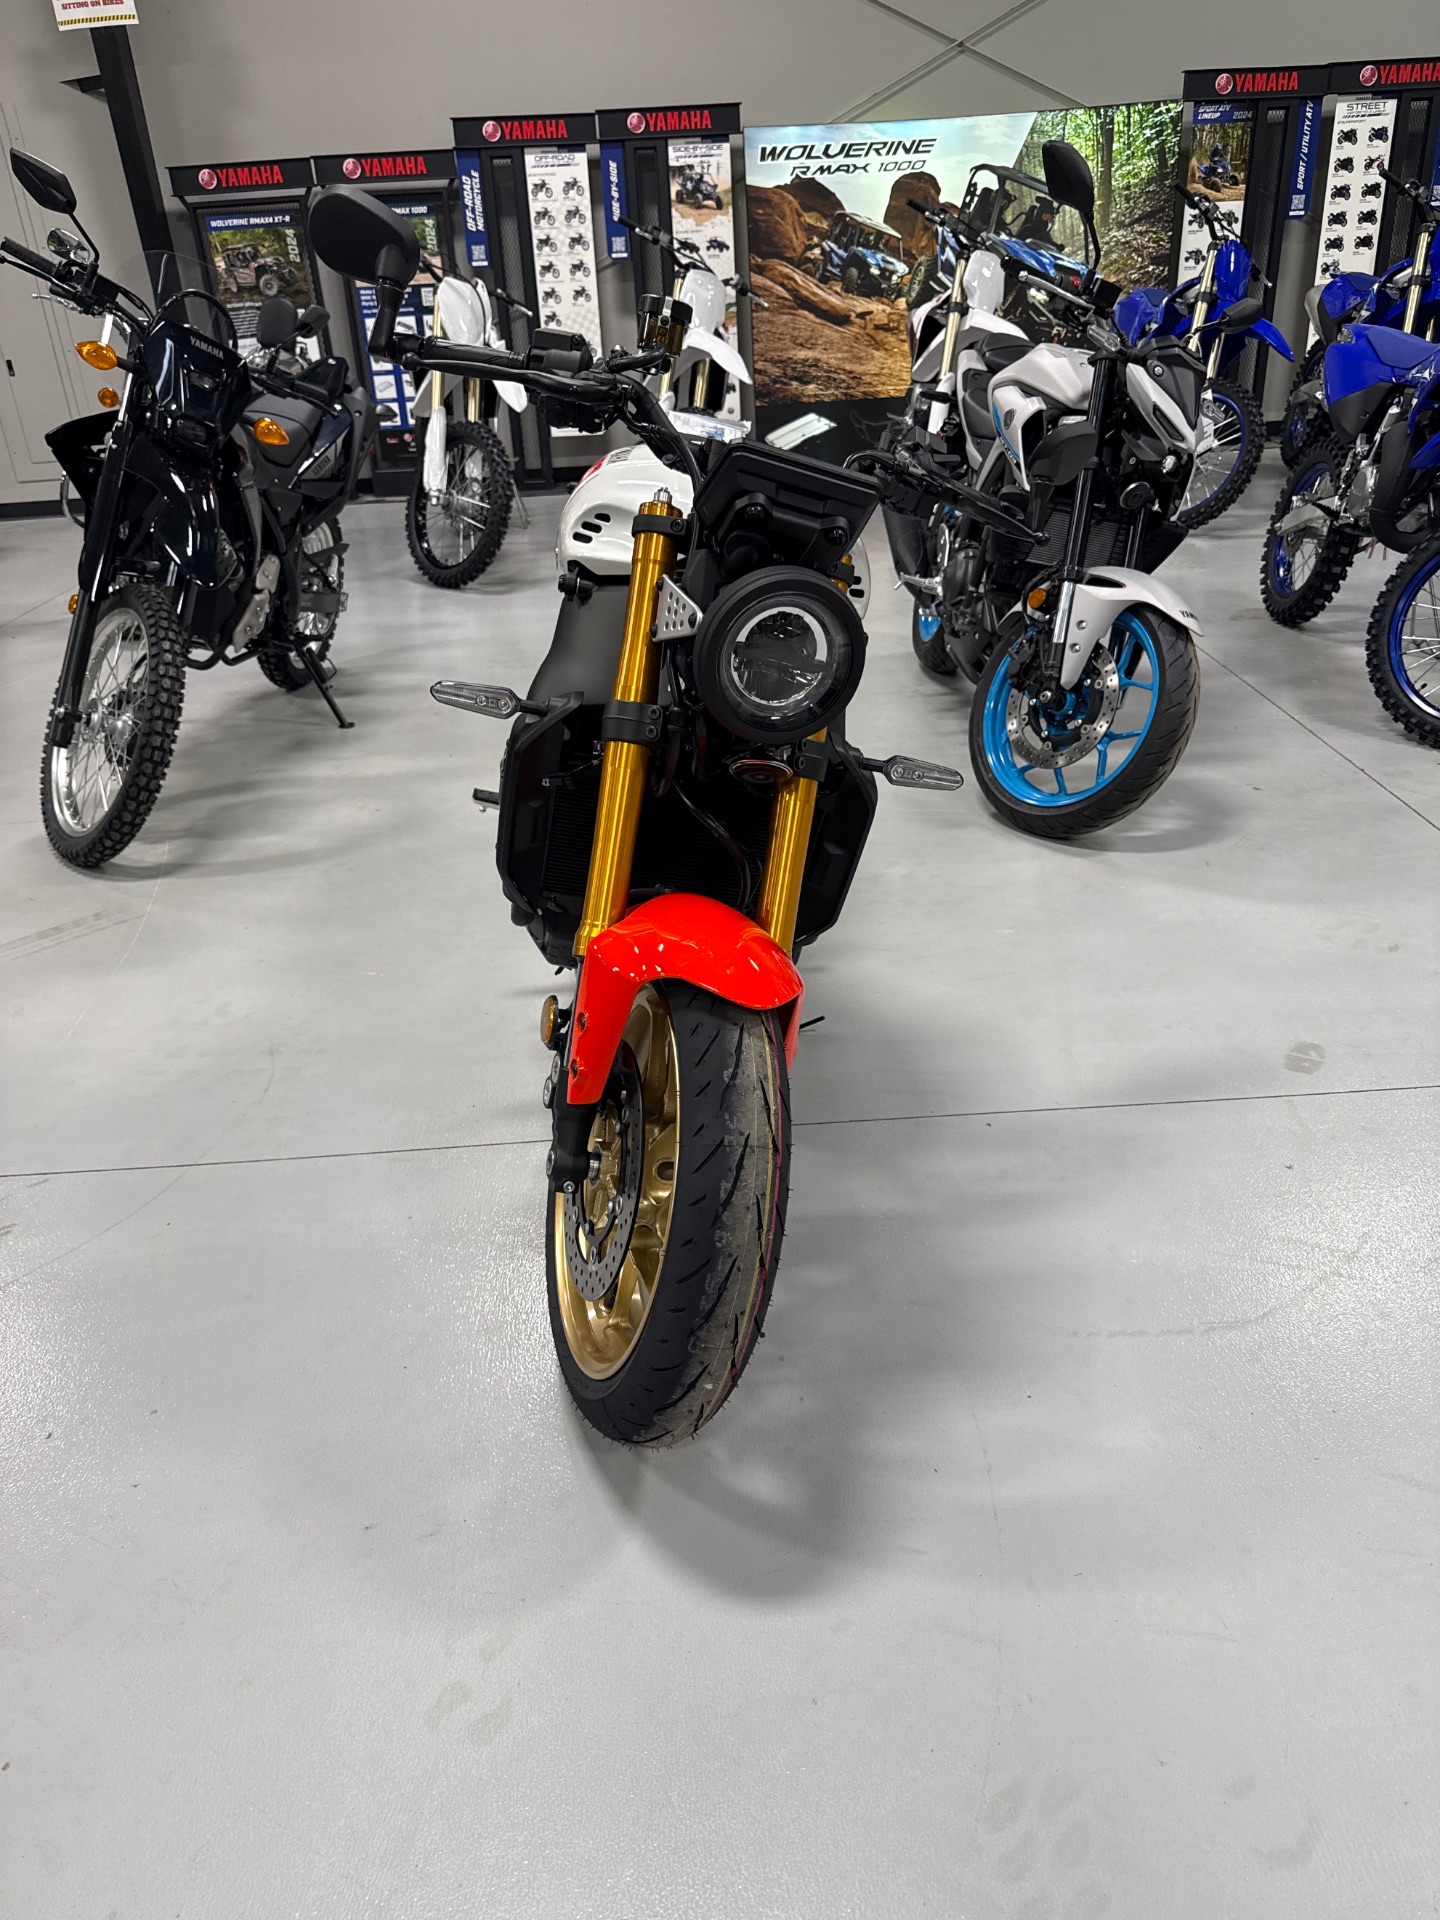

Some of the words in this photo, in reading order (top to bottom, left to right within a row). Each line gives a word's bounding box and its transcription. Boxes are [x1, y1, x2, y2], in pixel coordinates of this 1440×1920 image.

[61, 1, 89, 10] SITTING
[1235, 71, 1299, 93] YAMAHA
[1380, 63, 1440, 84] YAMAHA
[1233, 111, 1253, 119] 2024
[1305, 100, 1314, 119] ATV
[1346, 101, 1388, 111] STREET
[502, 120, 568, 140] YAMAHA
[646, 110, 712, 132] YAMAHA
[1301, 119, 1312, 153] UTILITY
[760, 138, 937, 162] WOLVERINE
[217, 165, 284, 187] YAMAHA
[361, 156, 428, 177] YAMAHA
[878, 160, 927, 172] 1000
[1297, 160, 1307, 190] SPORT
[471, 170, 485, 232] MOTORCYCLE
[609, 160, 620, 221] SIDE-BY-SIDE
[411, 206, 428, 214] 1000
[462, 175, 476, 232] OFF-ROAD
[210, 219, 249, 228] WOLVERINE
[249, 217, 273, 225] RMAX4
[274, 215, 291, 223] XT-R
[285, 228, 301, 263] 2024
[424, 219, 438, 251] 2024
[190, 336, 224, 360] YAMAHA
